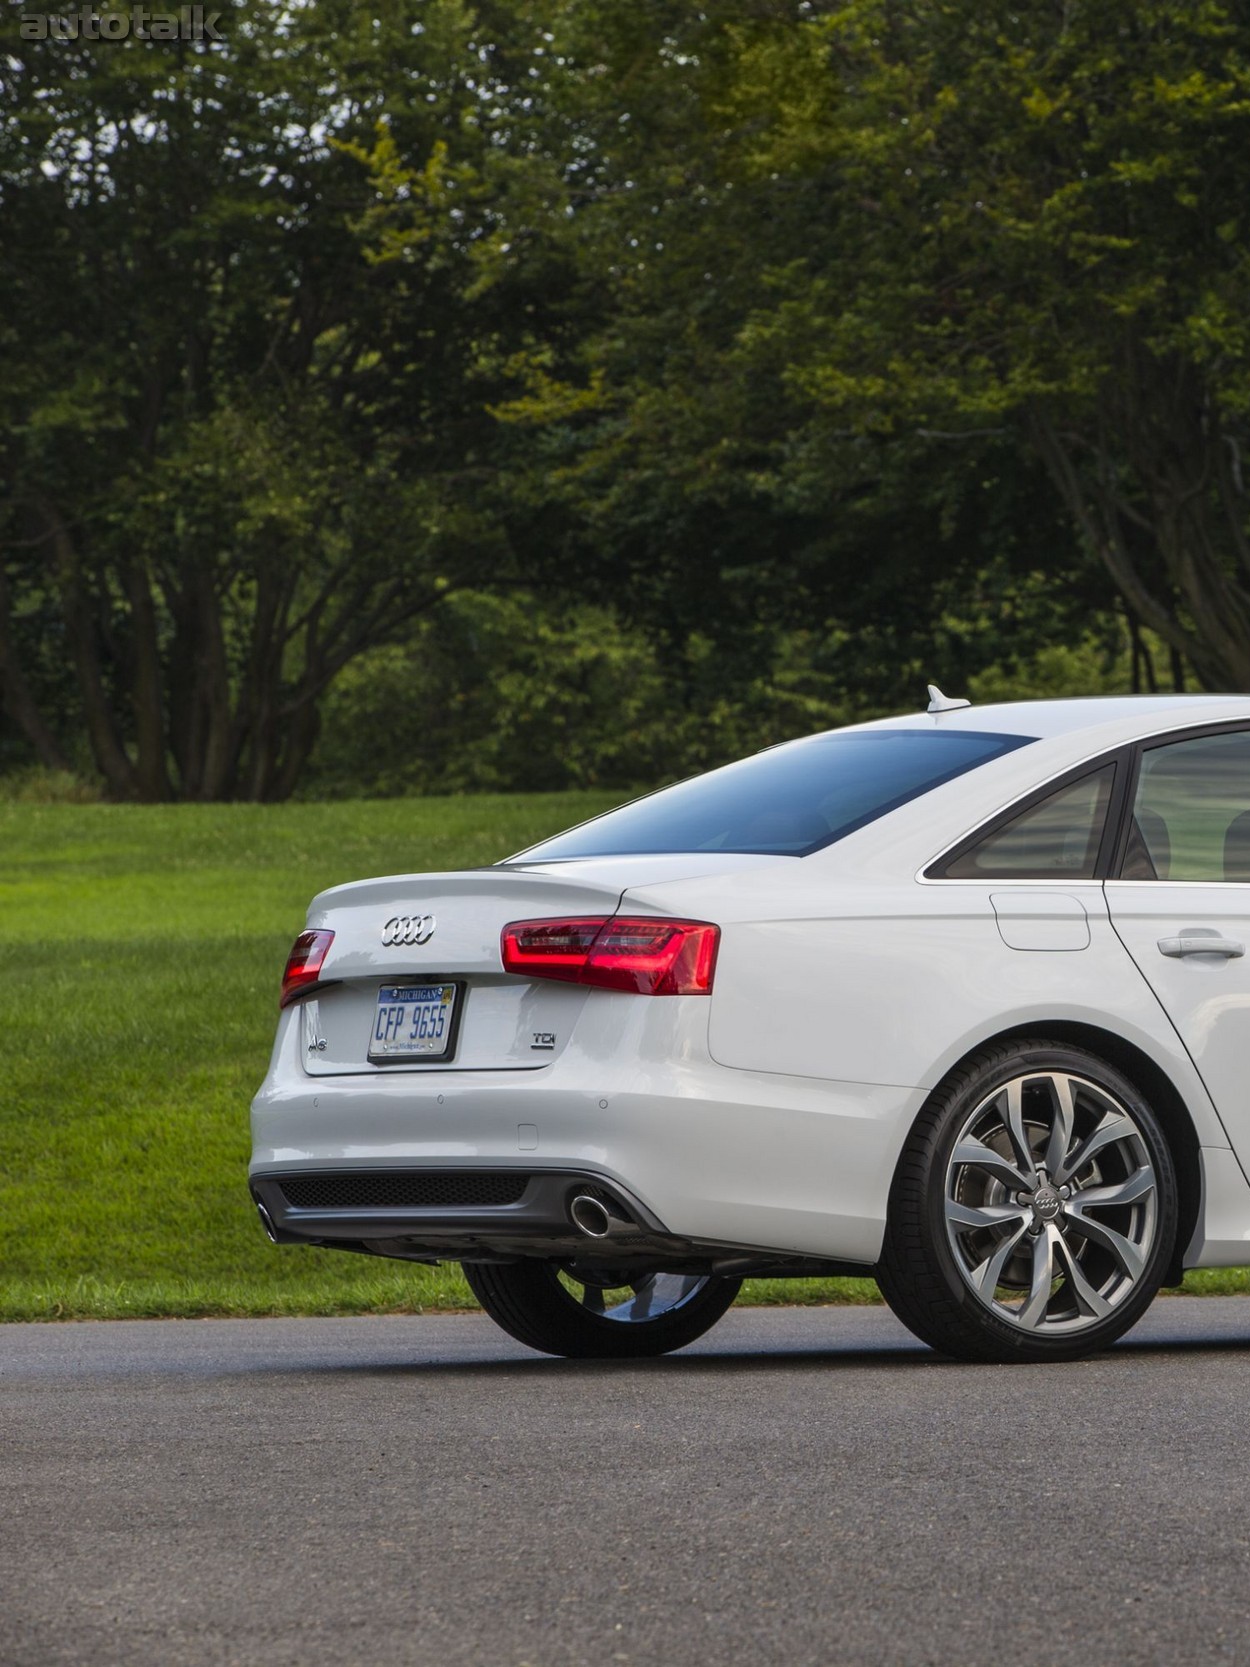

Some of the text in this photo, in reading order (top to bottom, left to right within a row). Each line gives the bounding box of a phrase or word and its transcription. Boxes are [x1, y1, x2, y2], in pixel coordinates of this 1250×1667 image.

[398, 989, 438, 1001] MICHIGAN
[375, 1004, 447, 1041] CFP 9655
